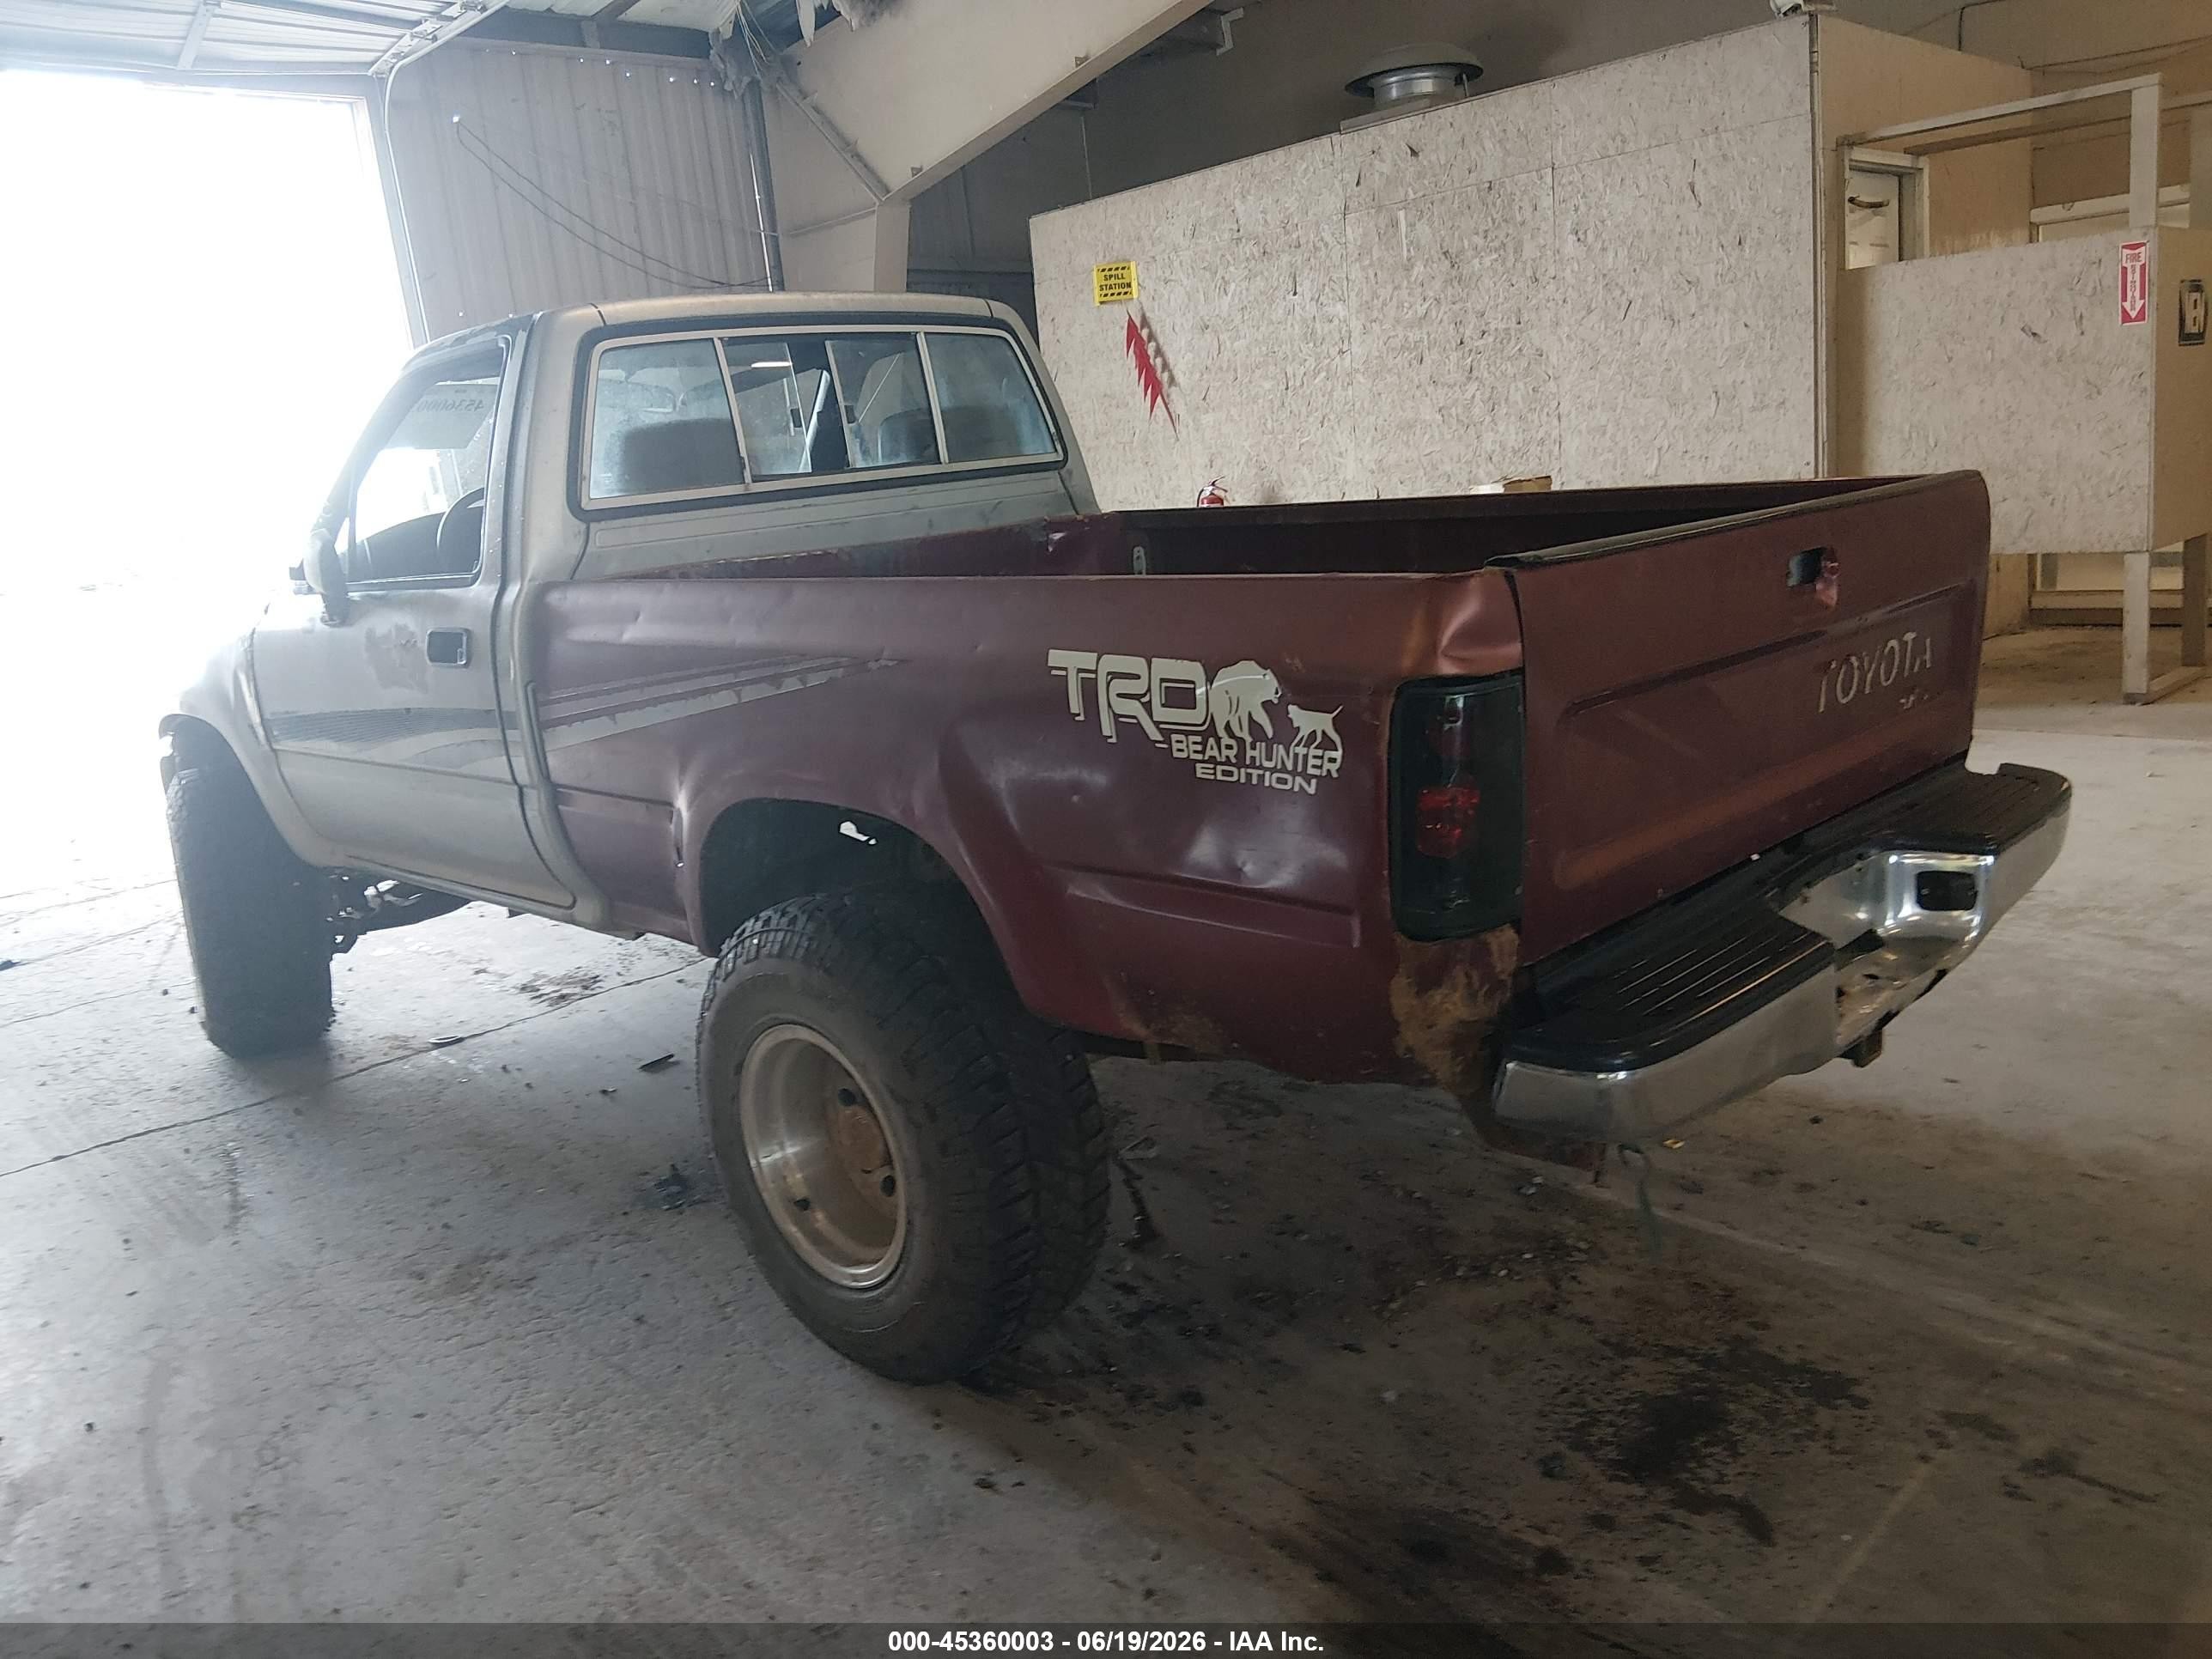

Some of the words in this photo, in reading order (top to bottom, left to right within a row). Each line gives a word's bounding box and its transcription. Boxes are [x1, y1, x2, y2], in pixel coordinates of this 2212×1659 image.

[2125, 252, 2142, 264] FIRE
[1099, 282, 1132, 292] STATION
[1103, 273, 1126, 282] SPILL
[1819, 631, 1931, 714] TOYOTA
[1048, 649, 1210, 745] TRD
[1170, 733, 1238, 763] BEAR
[1245, 742, 1343, 778] HUNTER
[1195, 763, 1317, 795] EDITION
